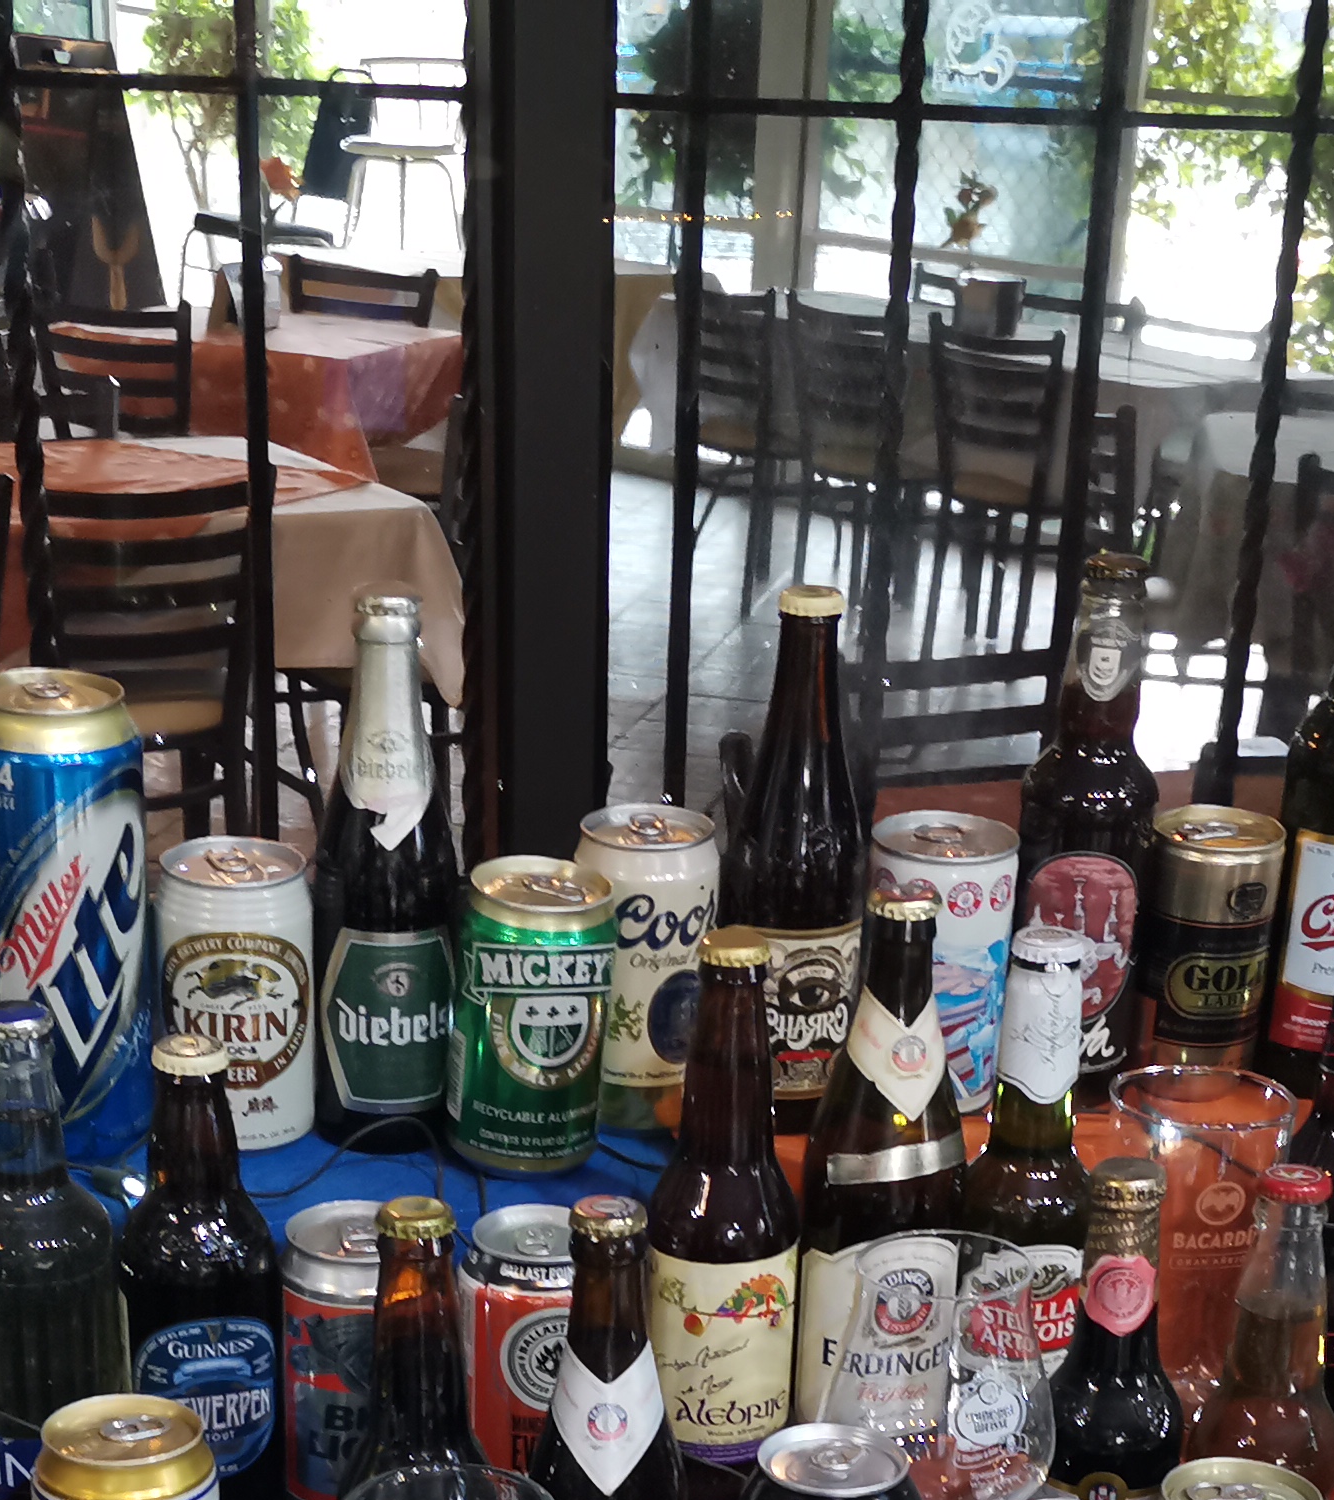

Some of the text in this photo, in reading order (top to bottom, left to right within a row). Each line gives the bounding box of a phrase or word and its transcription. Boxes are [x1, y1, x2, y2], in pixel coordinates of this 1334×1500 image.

[183, 1007, 289, 1043] KIRIN
[334, 998, 450, 1047] diebels
[226, 1064, 258, 1083] EER
[167, 1335, 257, 1360] GUINNESS
